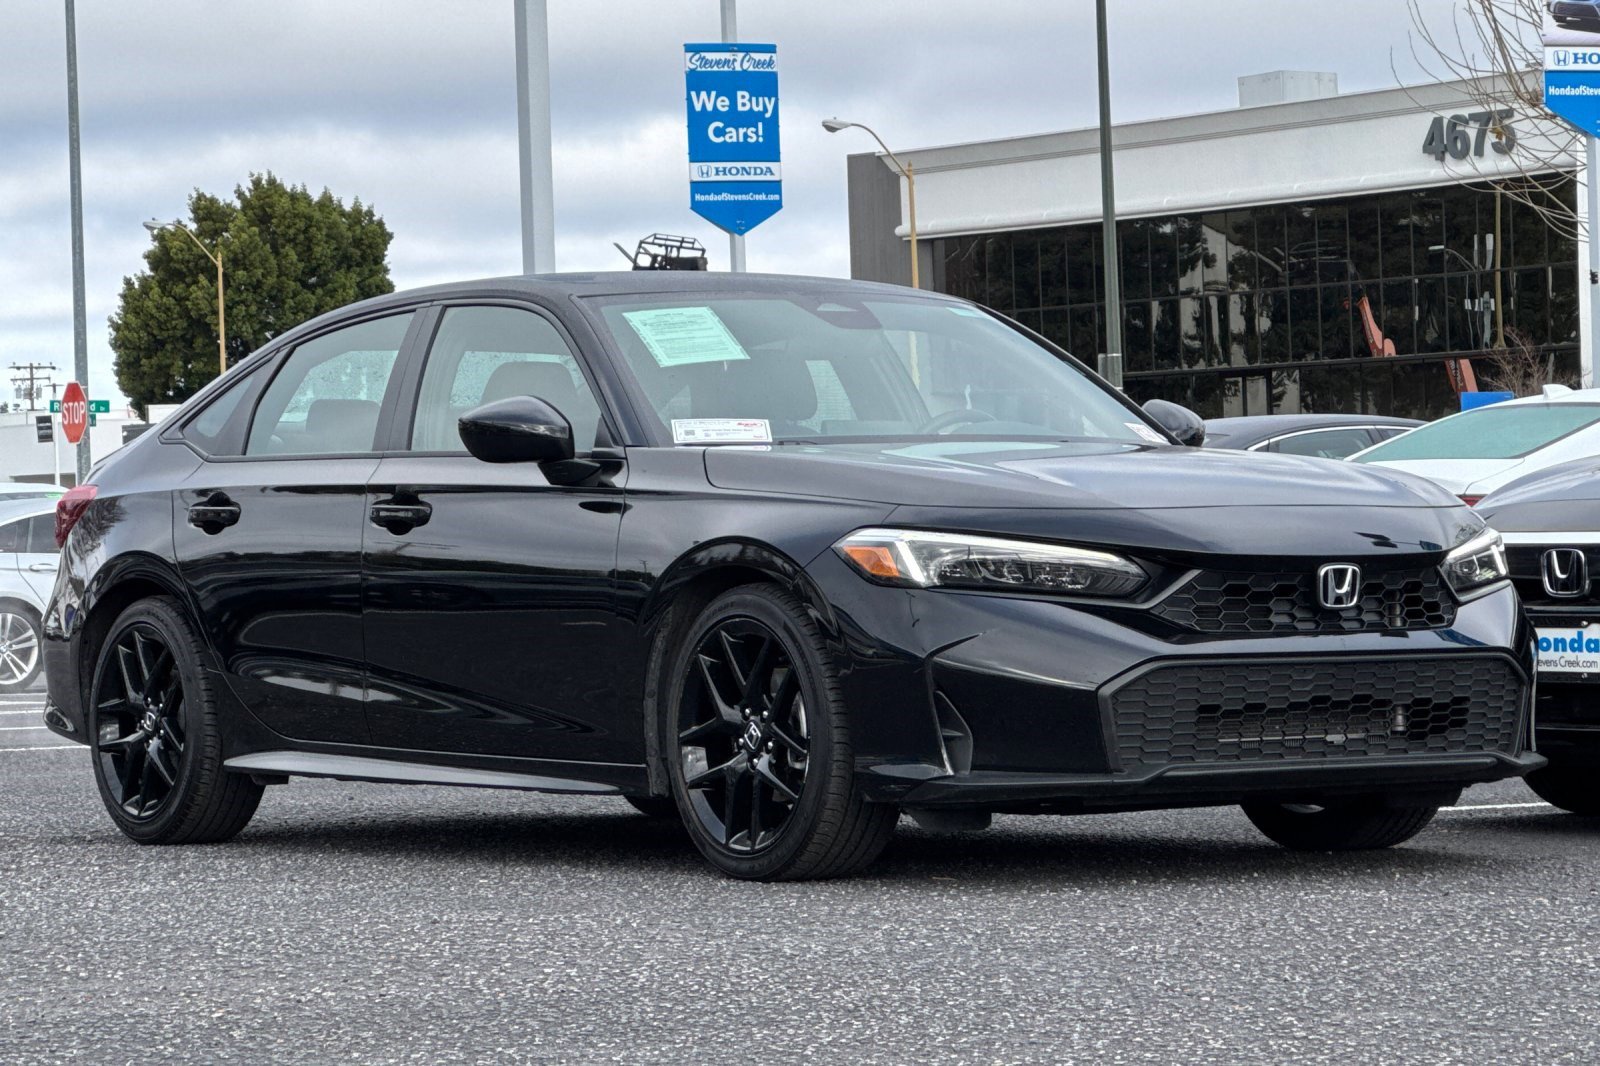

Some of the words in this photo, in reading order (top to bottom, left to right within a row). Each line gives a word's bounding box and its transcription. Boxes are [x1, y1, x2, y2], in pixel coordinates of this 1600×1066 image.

[688, 52, 737, 71] Stevens
[740, 52, 775, 71] Creek
[1572, 52, 1600, 65] HO
[690, 90, 730, 112] We
[736, 90, 776, 118] Buy
[707, 121, 764, 143] Cars!
[1422, 108, 1516, 161] 4675
[714, 166, 775, 177] HONDA
[695, 192, 780, 201] HondaofStevensCreek.com
[62, 401, 86, 425] STOP
[1538, 630, 1600, 653] onda
[1537, 655, 1598, 669] evensCreek.com
